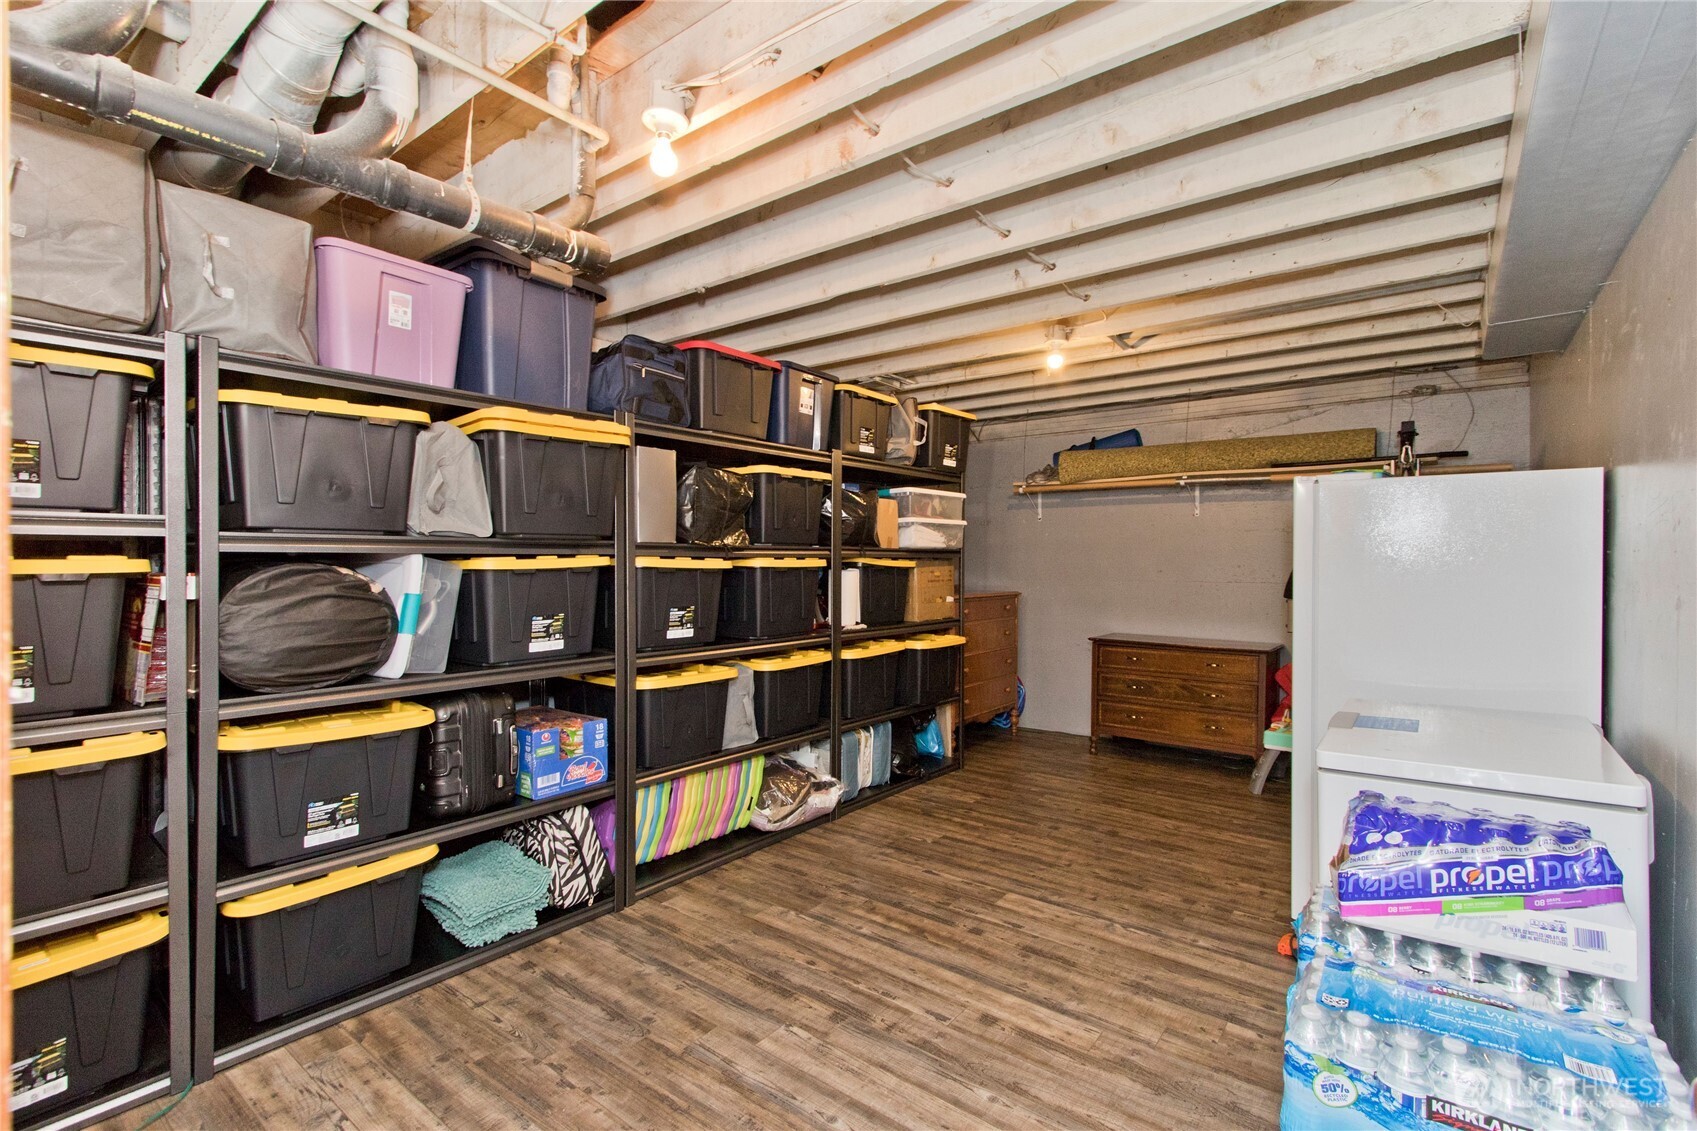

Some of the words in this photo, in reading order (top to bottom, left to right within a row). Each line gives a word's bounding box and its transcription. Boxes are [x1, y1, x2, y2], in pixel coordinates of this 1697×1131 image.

[1430, 859, 1534, 894] propel
[1439, 886, 1484, 894] FITNESS
[1321, 1082, 1350, 1094] 50%
[1431, 1099, 1529, 1131] KIRKLAN
